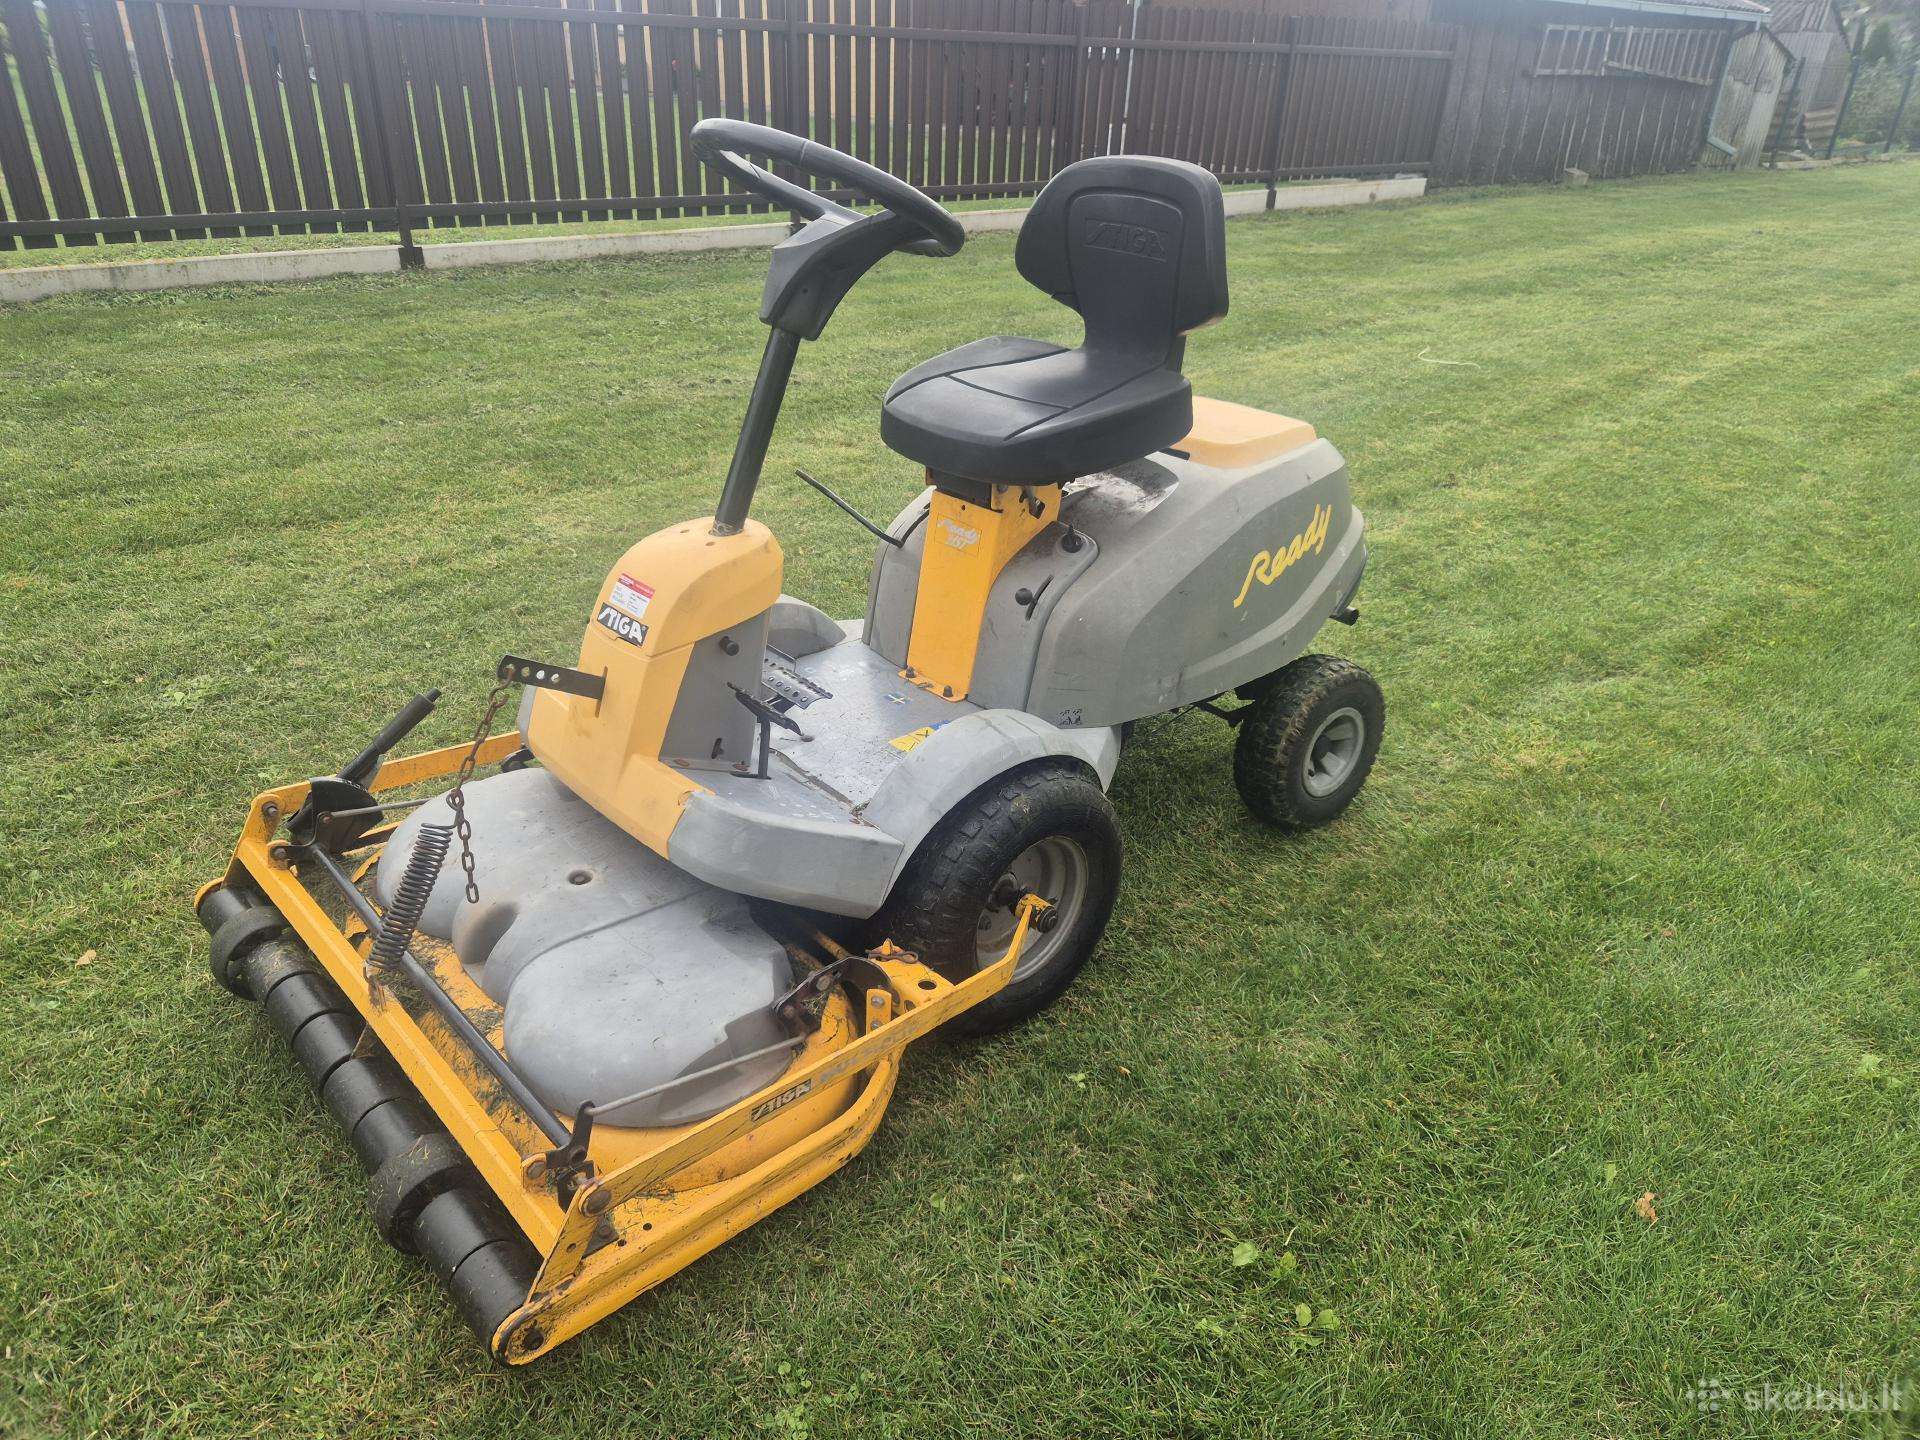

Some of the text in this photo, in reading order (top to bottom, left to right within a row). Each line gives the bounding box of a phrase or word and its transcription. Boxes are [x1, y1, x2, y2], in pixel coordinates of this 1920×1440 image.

[1233, 503, 1331, 608] Ready
[597, 606, 645, 643] STIGA
[752, 1081, 812, 1121] STIGA
